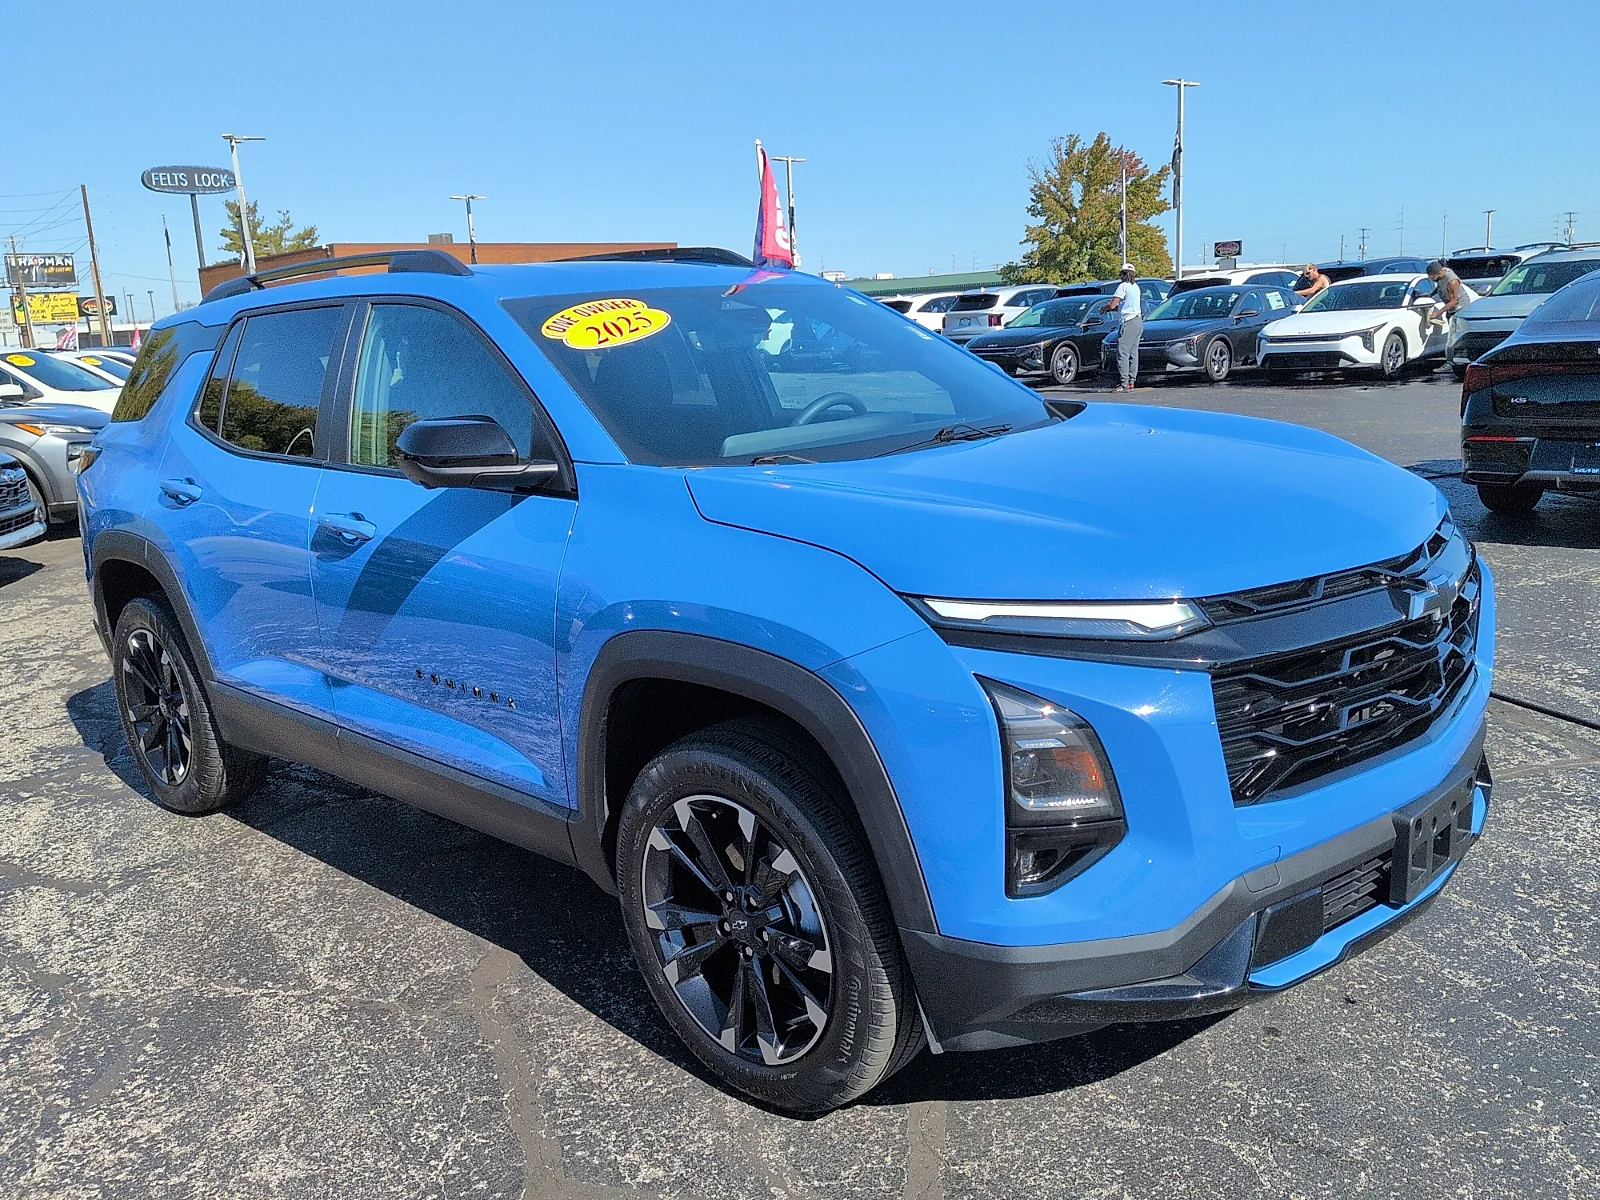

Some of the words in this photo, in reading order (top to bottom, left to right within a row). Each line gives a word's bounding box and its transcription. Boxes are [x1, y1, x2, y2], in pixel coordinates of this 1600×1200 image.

[151, 172, 188, 187] FELTS
[194, 173, 229, 187] LOCK
[546, 314, 580, 333] ONE
[572, 299, 637, 318] OWNER
[585, 311, 652, 344] 2025
